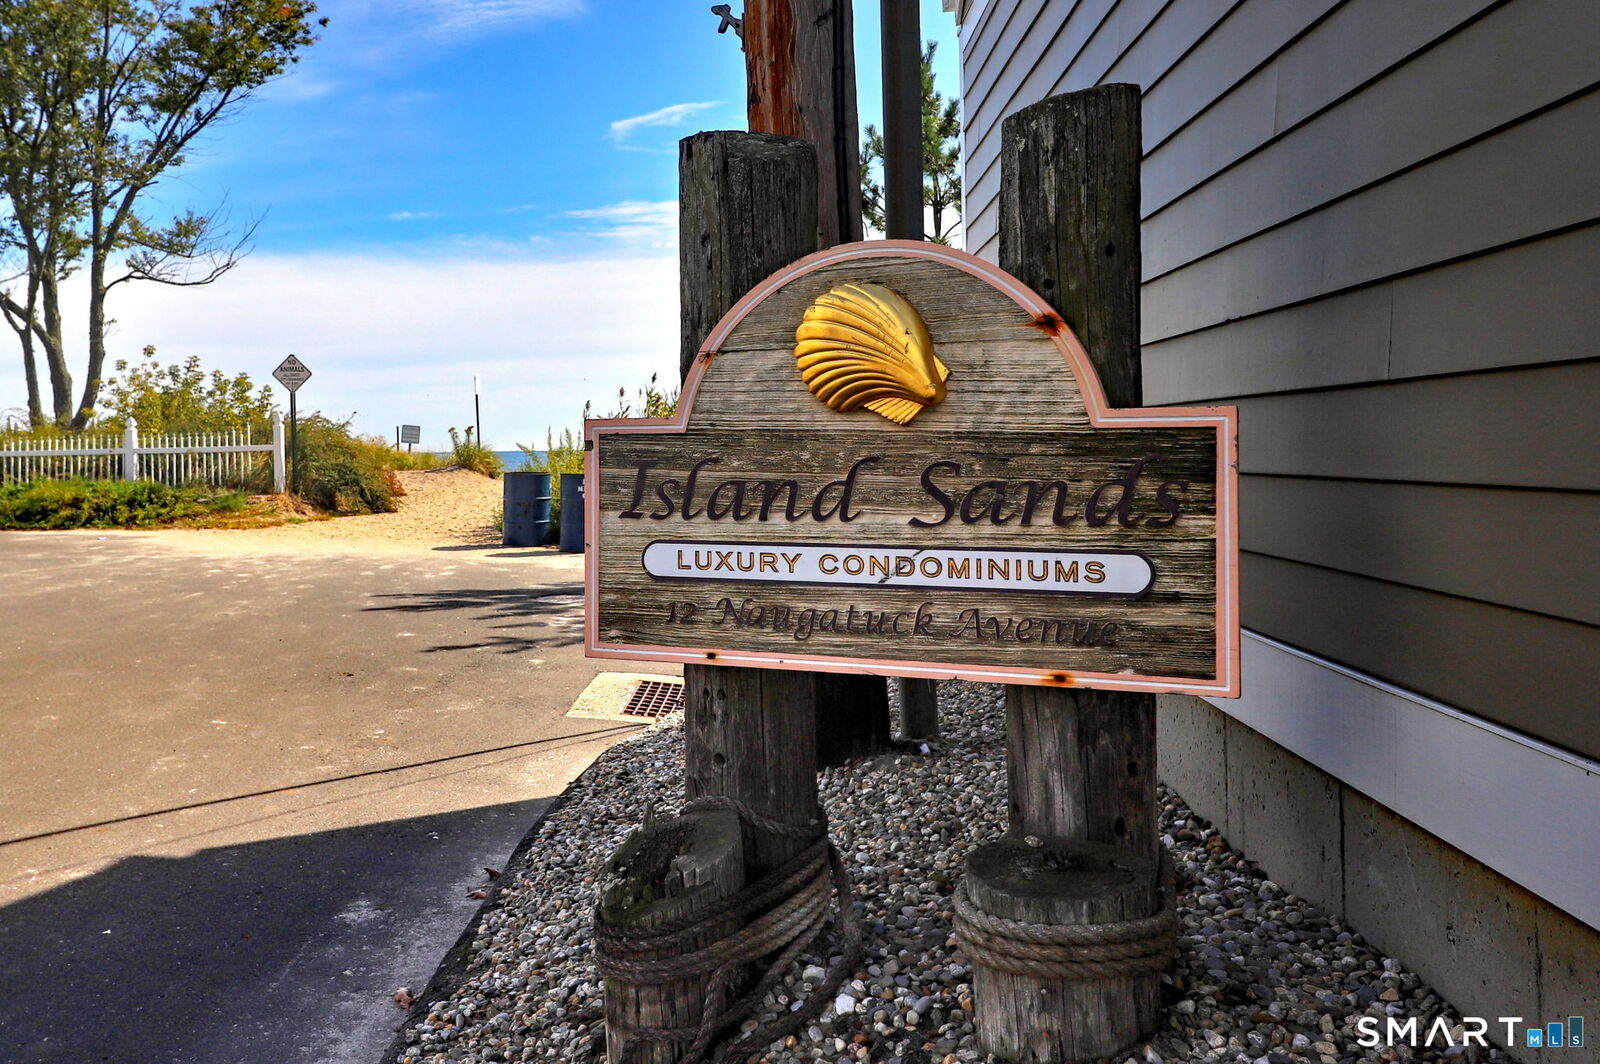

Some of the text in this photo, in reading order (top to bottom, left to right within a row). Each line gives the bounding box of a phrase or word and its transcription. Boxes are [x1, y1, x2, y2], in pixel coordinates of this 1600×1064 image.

[619, 453, 1189, 527] Island Sands
[677, 550, 1106, 584] LUXURY CONDOMINIUMS
[665, 597, 1121, 646] 12 Naugatuck Avenue
